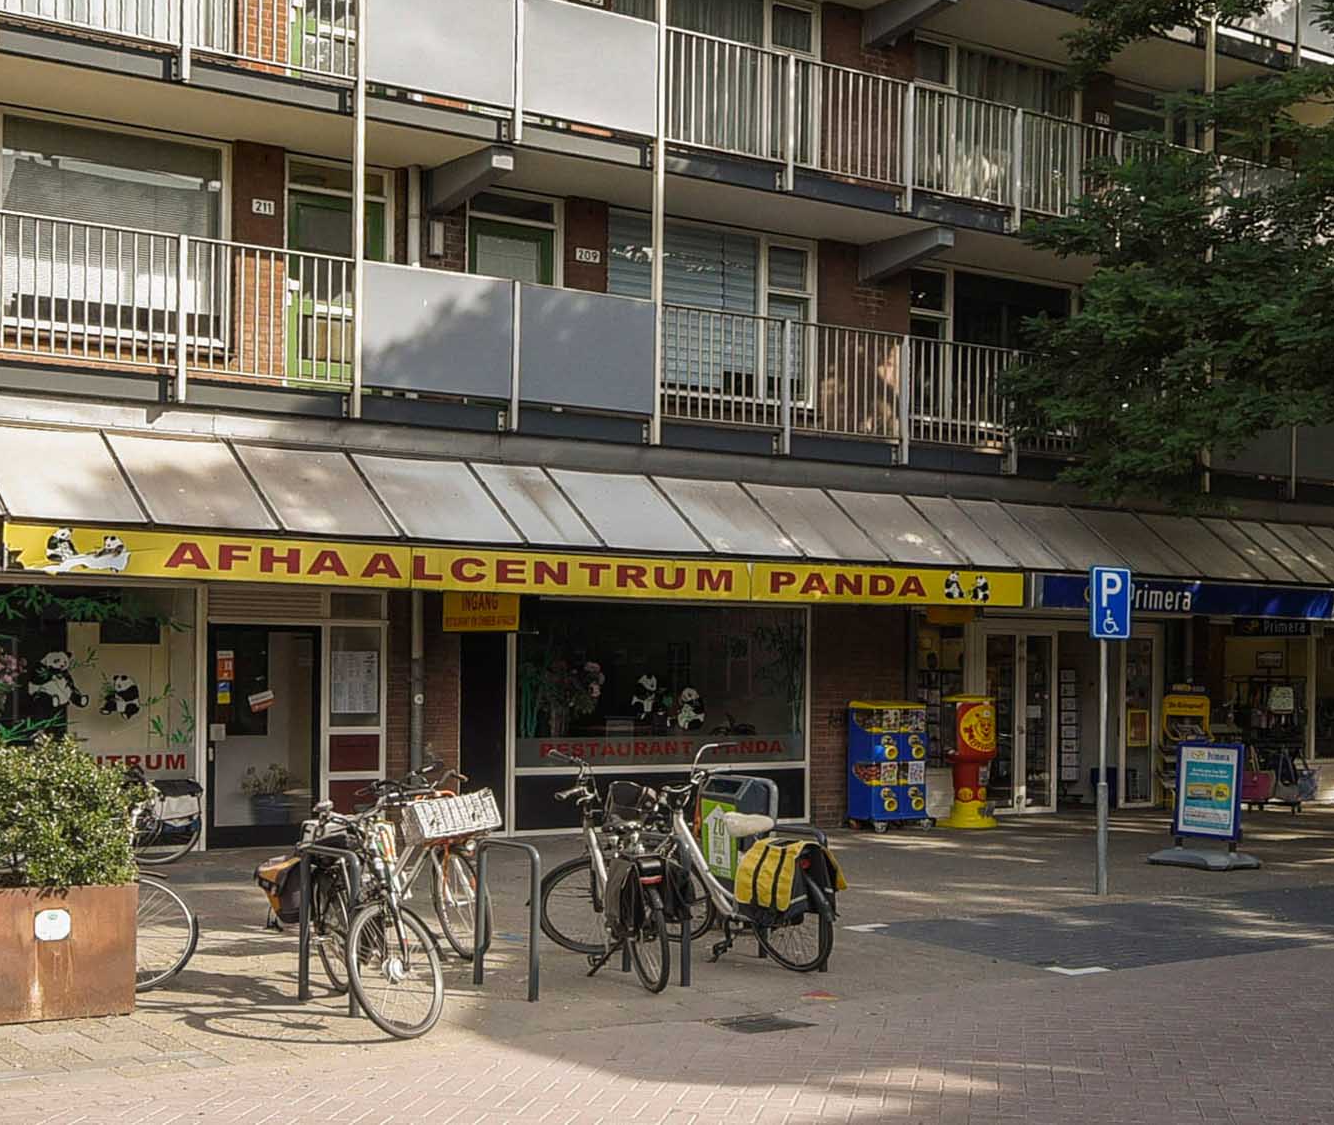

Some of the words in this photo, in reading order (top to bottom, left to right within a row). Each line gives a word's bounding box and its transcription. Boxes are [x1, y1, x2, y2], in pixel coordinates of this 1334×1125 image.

[255, 201, 272, 213] 211
[578, 249, 599, 261] 209
[769, 570, 927, 597] PANDA
[1100, 572, 1123, 608] P
[461, 593, 499, 612] INGANG
[1263, 620, 1307, 635] Primera
